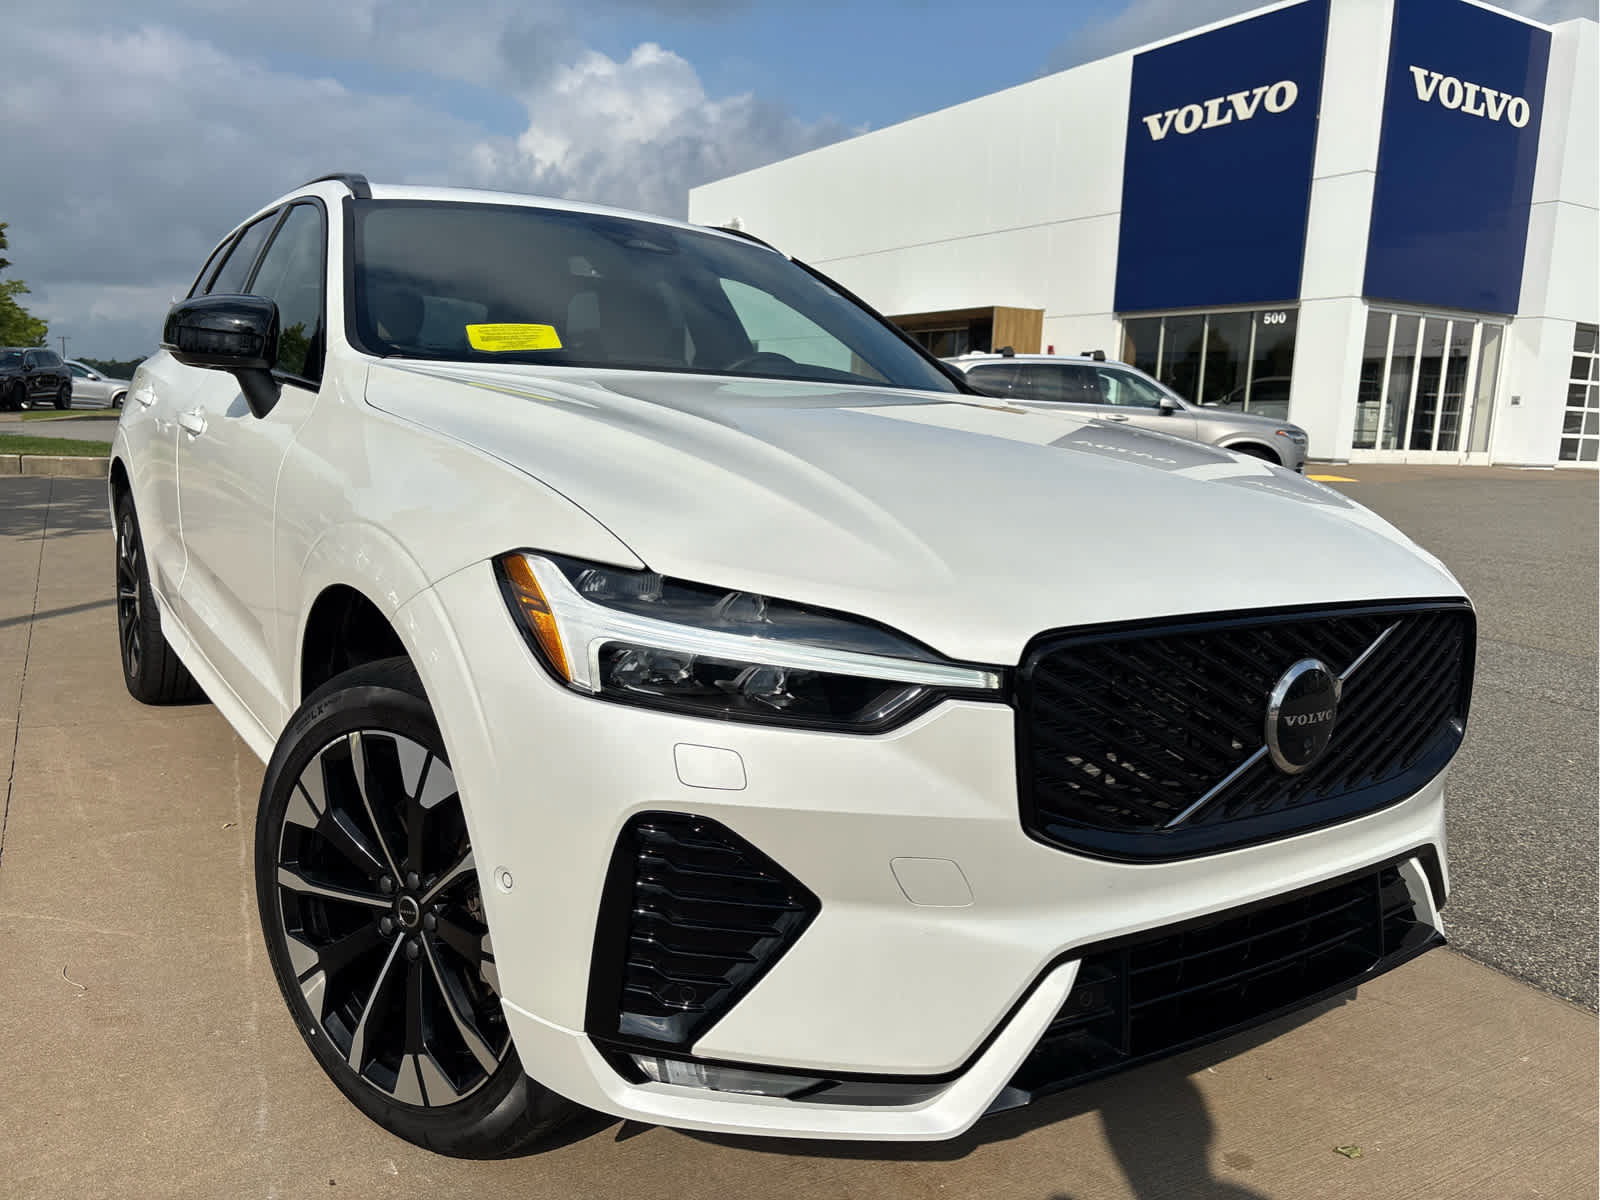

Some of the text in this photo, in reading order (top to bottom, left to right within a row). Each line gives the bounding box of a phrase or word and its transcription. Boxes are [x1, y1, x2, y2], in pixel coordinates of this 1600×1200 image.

[1143, 80, 1298, 141] VOLVO
[1410, 66, 1530, 128] VOLVO
[1263, 312, 1287, 324] 500
